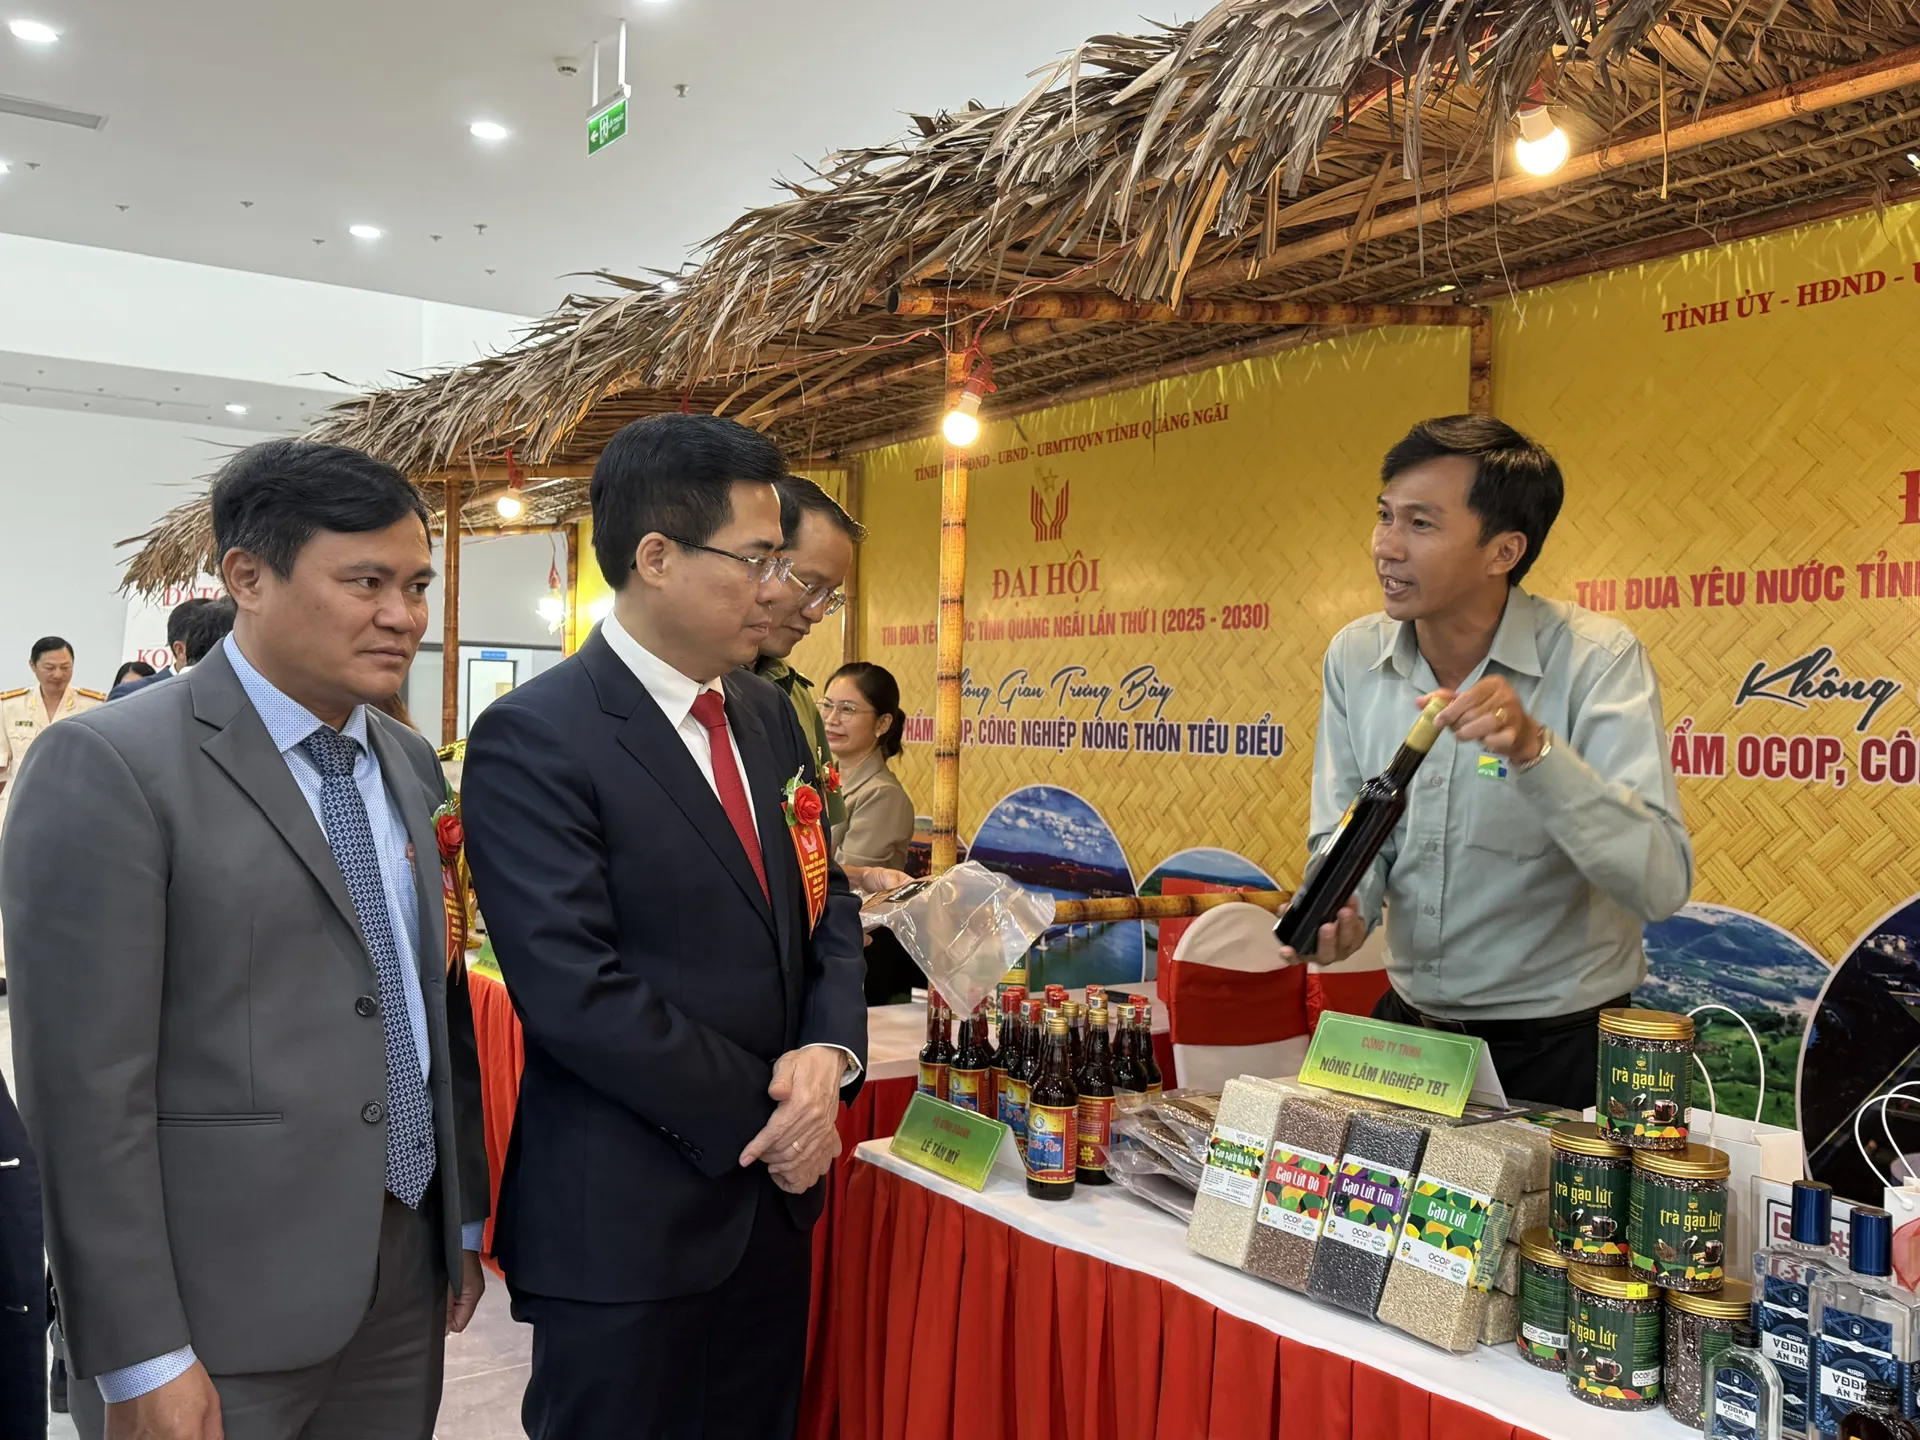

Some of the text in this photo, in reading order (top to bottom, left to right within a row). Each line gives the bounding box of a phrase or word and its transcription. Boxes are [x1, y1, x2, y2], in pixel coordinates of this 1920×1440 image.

[1662, 303, 1729, 333] TỈNH
[1737, 288, 1775, 319] ỦY
[1796, 270, 1886, 307] HĐND
[914, 464, 938, 481] TỈNH
[998, 446, 1029, 465] UBND
[1037, 431, 1104, 458] UBMTTQVN
[1107, 422, 1139, 444] TỈNH
[1142, 411, 1190, 439] QUẢNG
[1193, 402, 1230, 426] NGÃI
[992, 549, 1100, 608] ĐẠI HỘI
[1576, 550, 1920, 612] THI ĐUA YÊU NƯỚC TỈN
[882, 627, 897, 646] THI
[900, 624, 919, 646] ĐUA
[923, 620, 938, 645] YÊ
[1008, 611, 1050, 641] QUẢNG
[1054, 611, 1085, 638] NGÃI
[1120, 606, 1150, 634] THỨ
[1162, 607, 1205, 635] (2025
[1221, 602, 1270, 631] 2030)
[961, 665, 1174, 718] hông Gian Trưng Bày
[1735, 648, 1901, 731] Không
[905, 708, 934, 742] HẨM
[978, 714, 1017, 746] CÔNG
[1021, 715, 1077, 754] NGHIỆP
[1082, 715, 1129, 750] NÔNG
[1134, 717, 1182, 752] THÔN
[1187, 718, 1229, 755] TIÊU
[1235, 712, 1284, 757] BIỂU
[1670, 718, 1920, 786] ẨM OCOP, CÔ
[1361, 1035, 1386, 1052] CÔNG
[1387, 1040, 1397, 1055] TY
[1319, 1056, 1449, 1098] NÔNG LÂM NGHIỆP TBT
[1612, 1066, 1676, 1092] trà gạo lứt
[1275, 1166, 1320, 1192] Gạo Lứt Đỏ
[1341, 1178, 1394, 1207] Gạo Lứt Tím
[1555, 1181, 1613, 1209] trà gạo lứt
[1427, 1200, 1468, 1229] Gạo Lứt
[1660, 1208, 1680, 1227] trà
[1683, 1214, 1706, 1233] gạo
[1352, 1227, 1373, 1239] OCOP
[1428, 1252, 1451, 1266] OCOP
[1577, 1324, 1596, 1343] gạo
[1599, 1325, 1618, 1351] lứt
[1772, 1338, 1808, 1357] VODK
